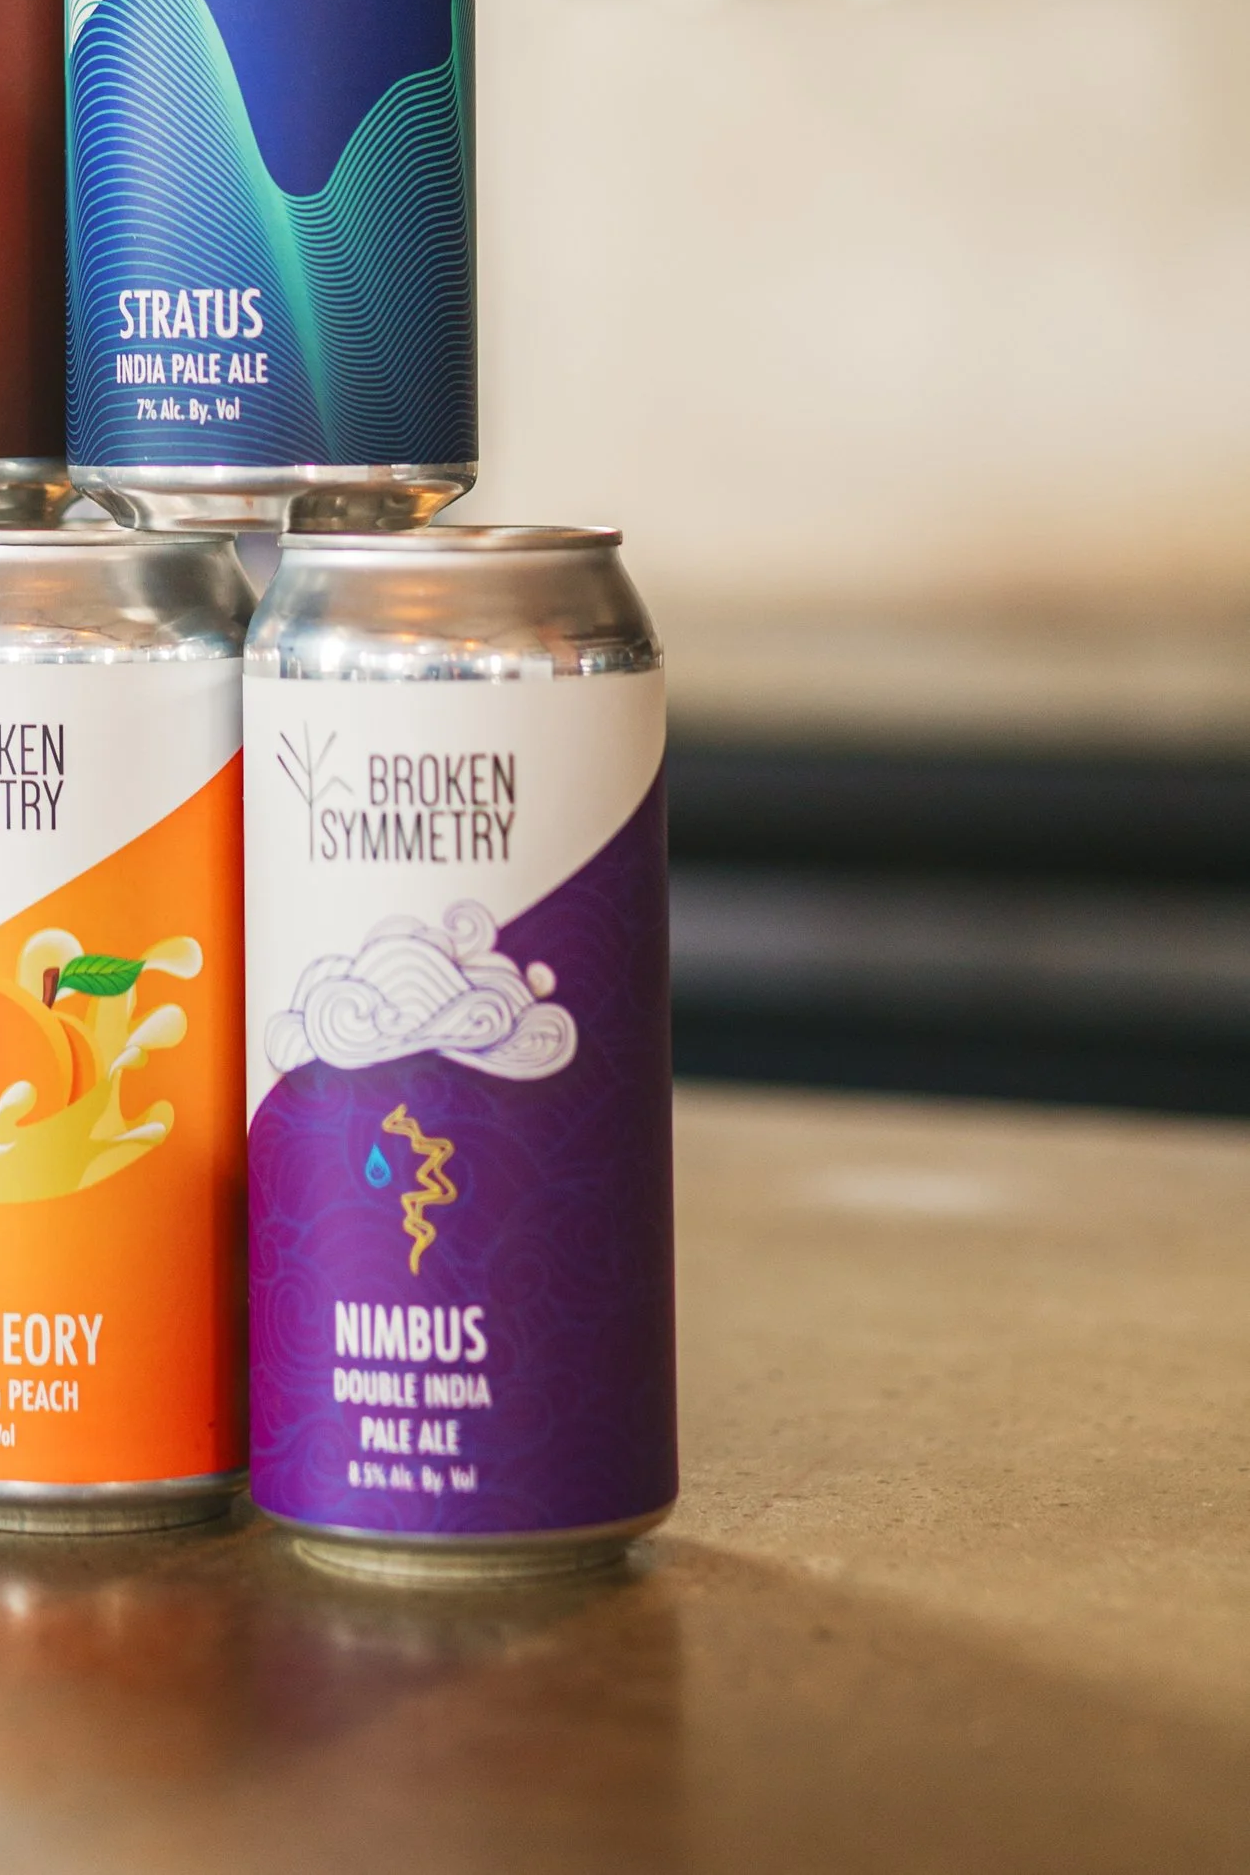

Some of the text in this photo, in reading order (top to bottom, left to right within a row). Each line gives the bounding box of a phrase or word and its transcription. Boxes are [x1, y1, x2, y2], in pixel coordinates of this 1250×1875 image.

[118, 288, 264, 339] STRATUS
[116, 352, 269, 385] INDIA PALE ALE
[137, 396, 240, 425] 7% Alc. By. Vol
[369, 752, 516, 807] BROKEN
[320, 809, 516, 862] SYMMETRY
[335, 1300, 488, 1363] NIMBUS
[8, 1378, 79, 1412] PEACH
[333, 1367, 493, 1409] DOUBLE INDIA
[361, 1416, 460, 1455] PALE ALE
[450, 1465, 478, 1493] Vol
